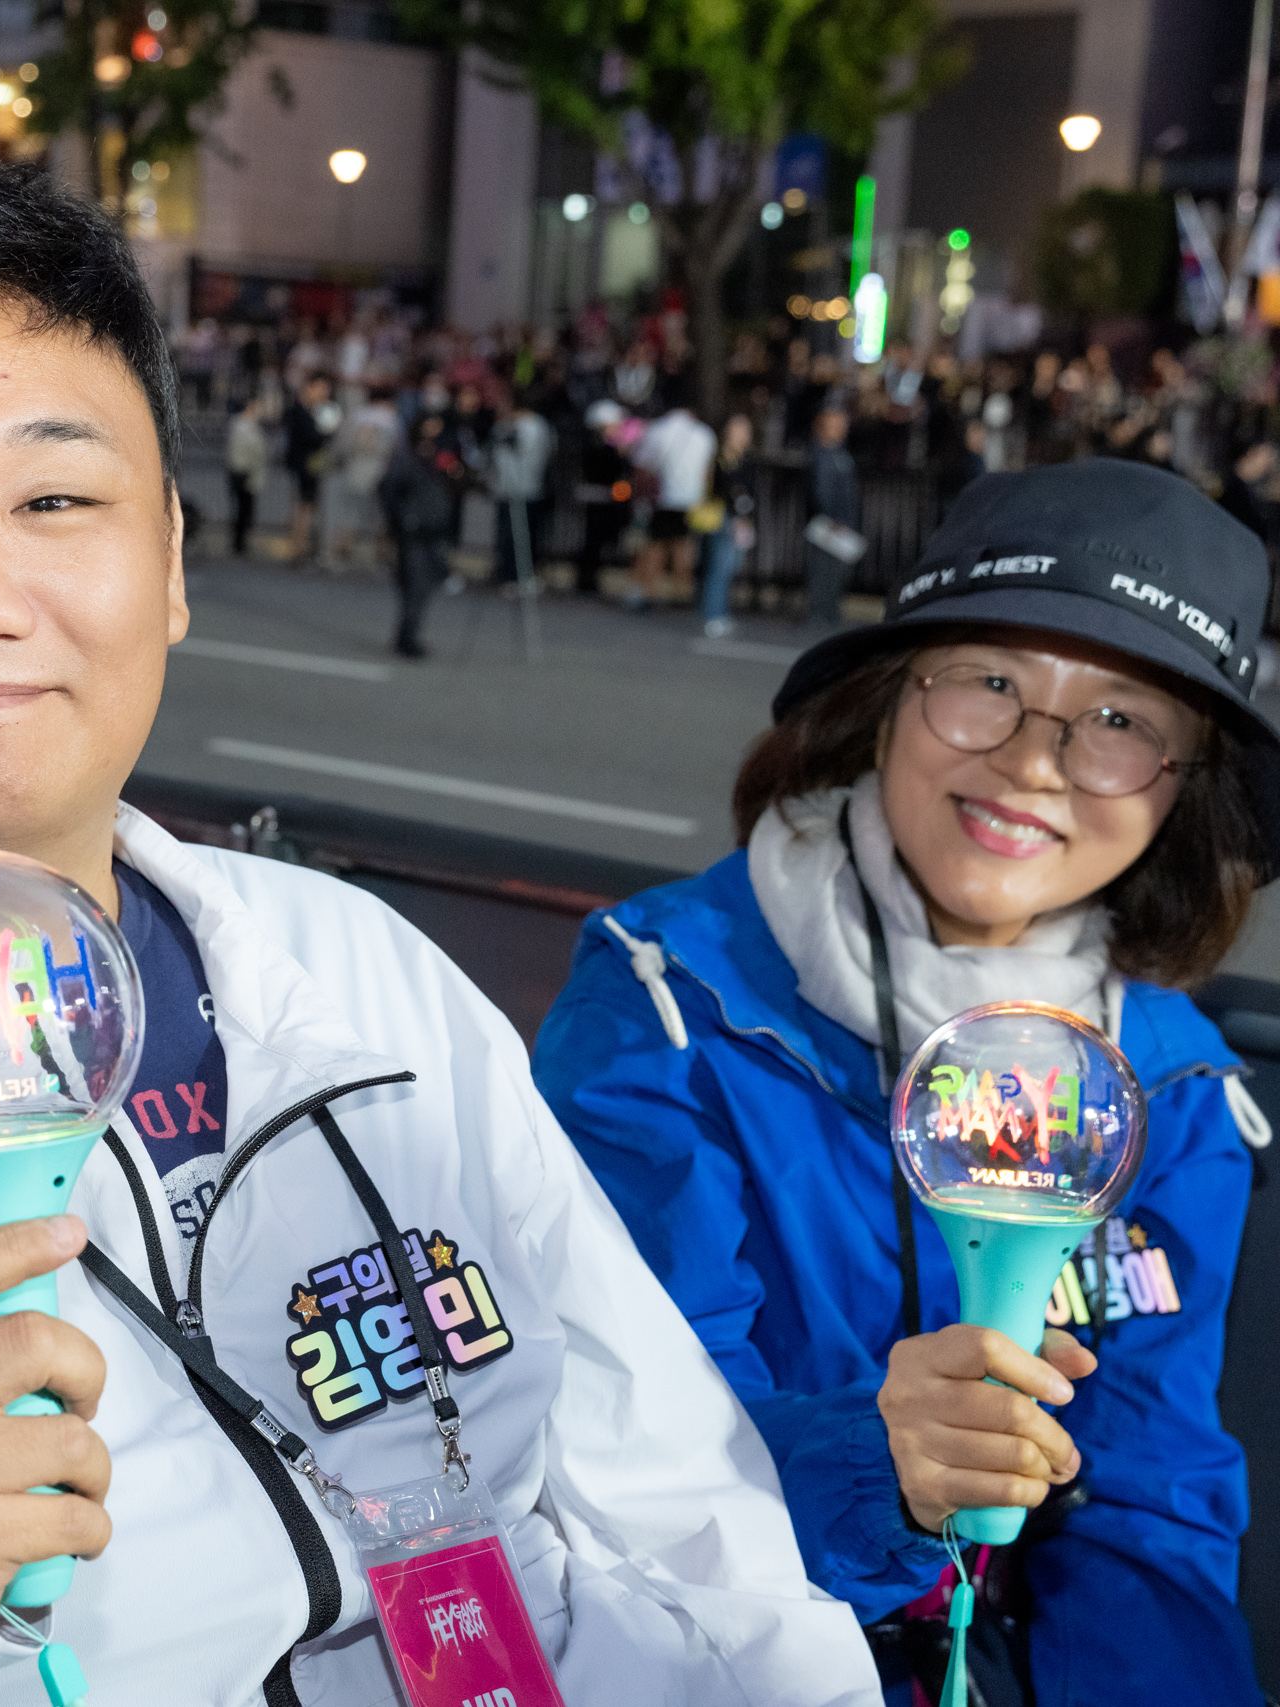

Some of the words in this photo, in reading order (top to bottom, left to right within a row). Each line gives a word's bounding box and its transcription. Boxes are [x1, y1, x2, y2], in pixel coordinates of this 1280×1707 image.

[992, 555, 1058, 576] BEST
[1110, 573, 1175, 611] PLAY
[1177, 600, 1226, 648] YOUR
[131, 1081, 220, 1140] OX
[290, 1265, 509, 1422] 김영민
[424, 1600, 462, 1656] HEY
